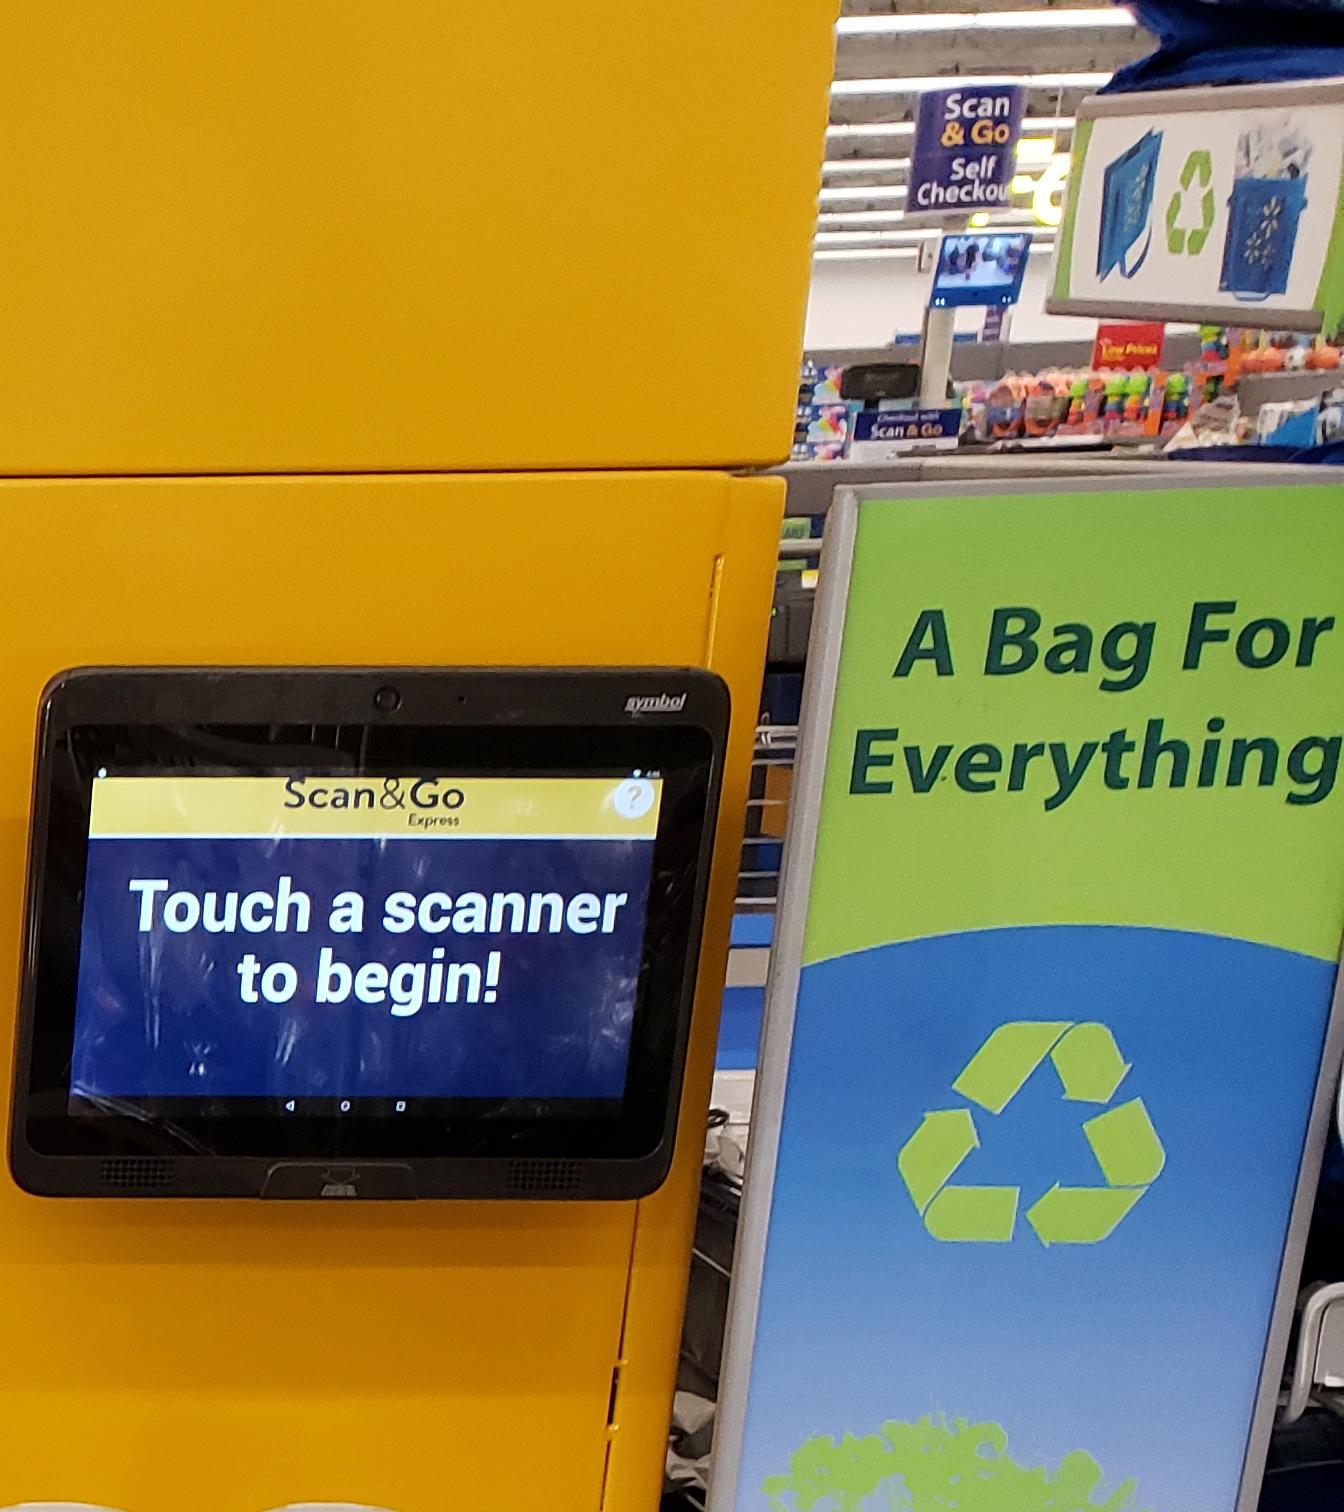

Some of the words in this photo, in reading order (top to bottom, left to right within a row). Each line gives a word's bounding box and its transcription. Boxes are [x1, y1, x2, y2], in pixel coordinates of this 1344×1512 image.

[944, 93, 1010, 120] Scan
[940, 121, 964, 147] &
[971, 119, 1010, 144] Go
[950, 155, 998, 180] Self
[917, 177, 1013, 205] Checkou
[871, 423, 904, 440] Scan
[892, 609, 954, 678] A
[984, 607, 1157, 692] Bag
[1182, 601, 1335, 670] For
[624, 693, 687, 717] symbol
[849, 717, 1343, 812] Everything
[408, 814, 459, 829] Express
[128, 877, 311, 933] Touch
[328, 890, 364, 933] a
[382, 889, 627, 934] scanner
[238, 953, 297, 1003] to
[315, 948, 501, 1016] begin!
